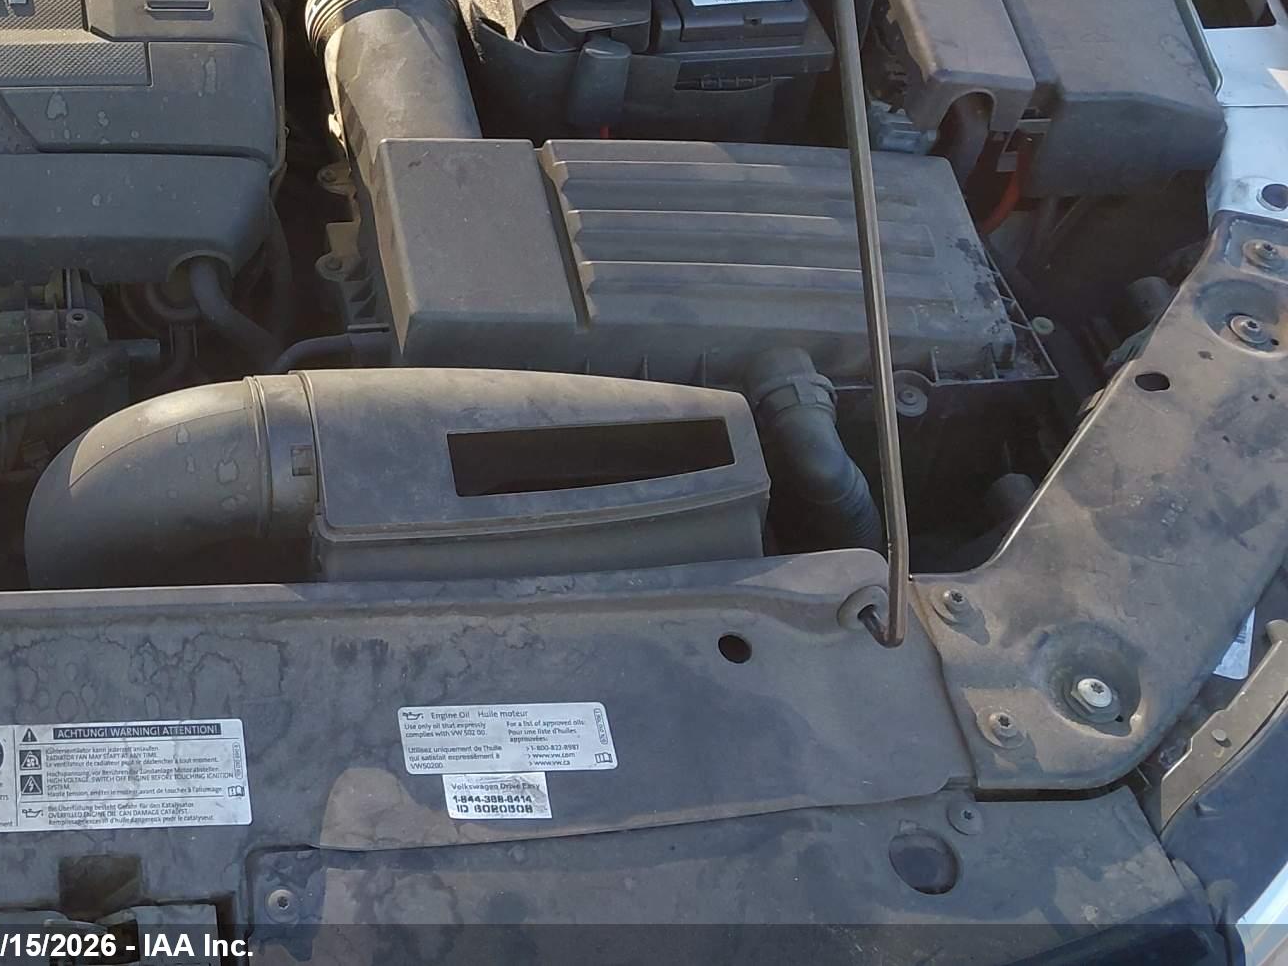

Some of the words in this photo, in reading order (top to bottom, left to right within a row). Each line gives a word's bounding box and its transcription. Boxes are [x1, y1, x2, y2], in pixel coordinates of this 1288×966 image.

[432, 712, 457, 721] Engine
[57, 728, 108, 738] ACHTUNG!
[110, 726, 160, 737] WARNING!
[162, 725, 217, 735] ATTENTION!
[452, 783, 498, 791] Volkswagen
[456, 805, 469, 813] ID
